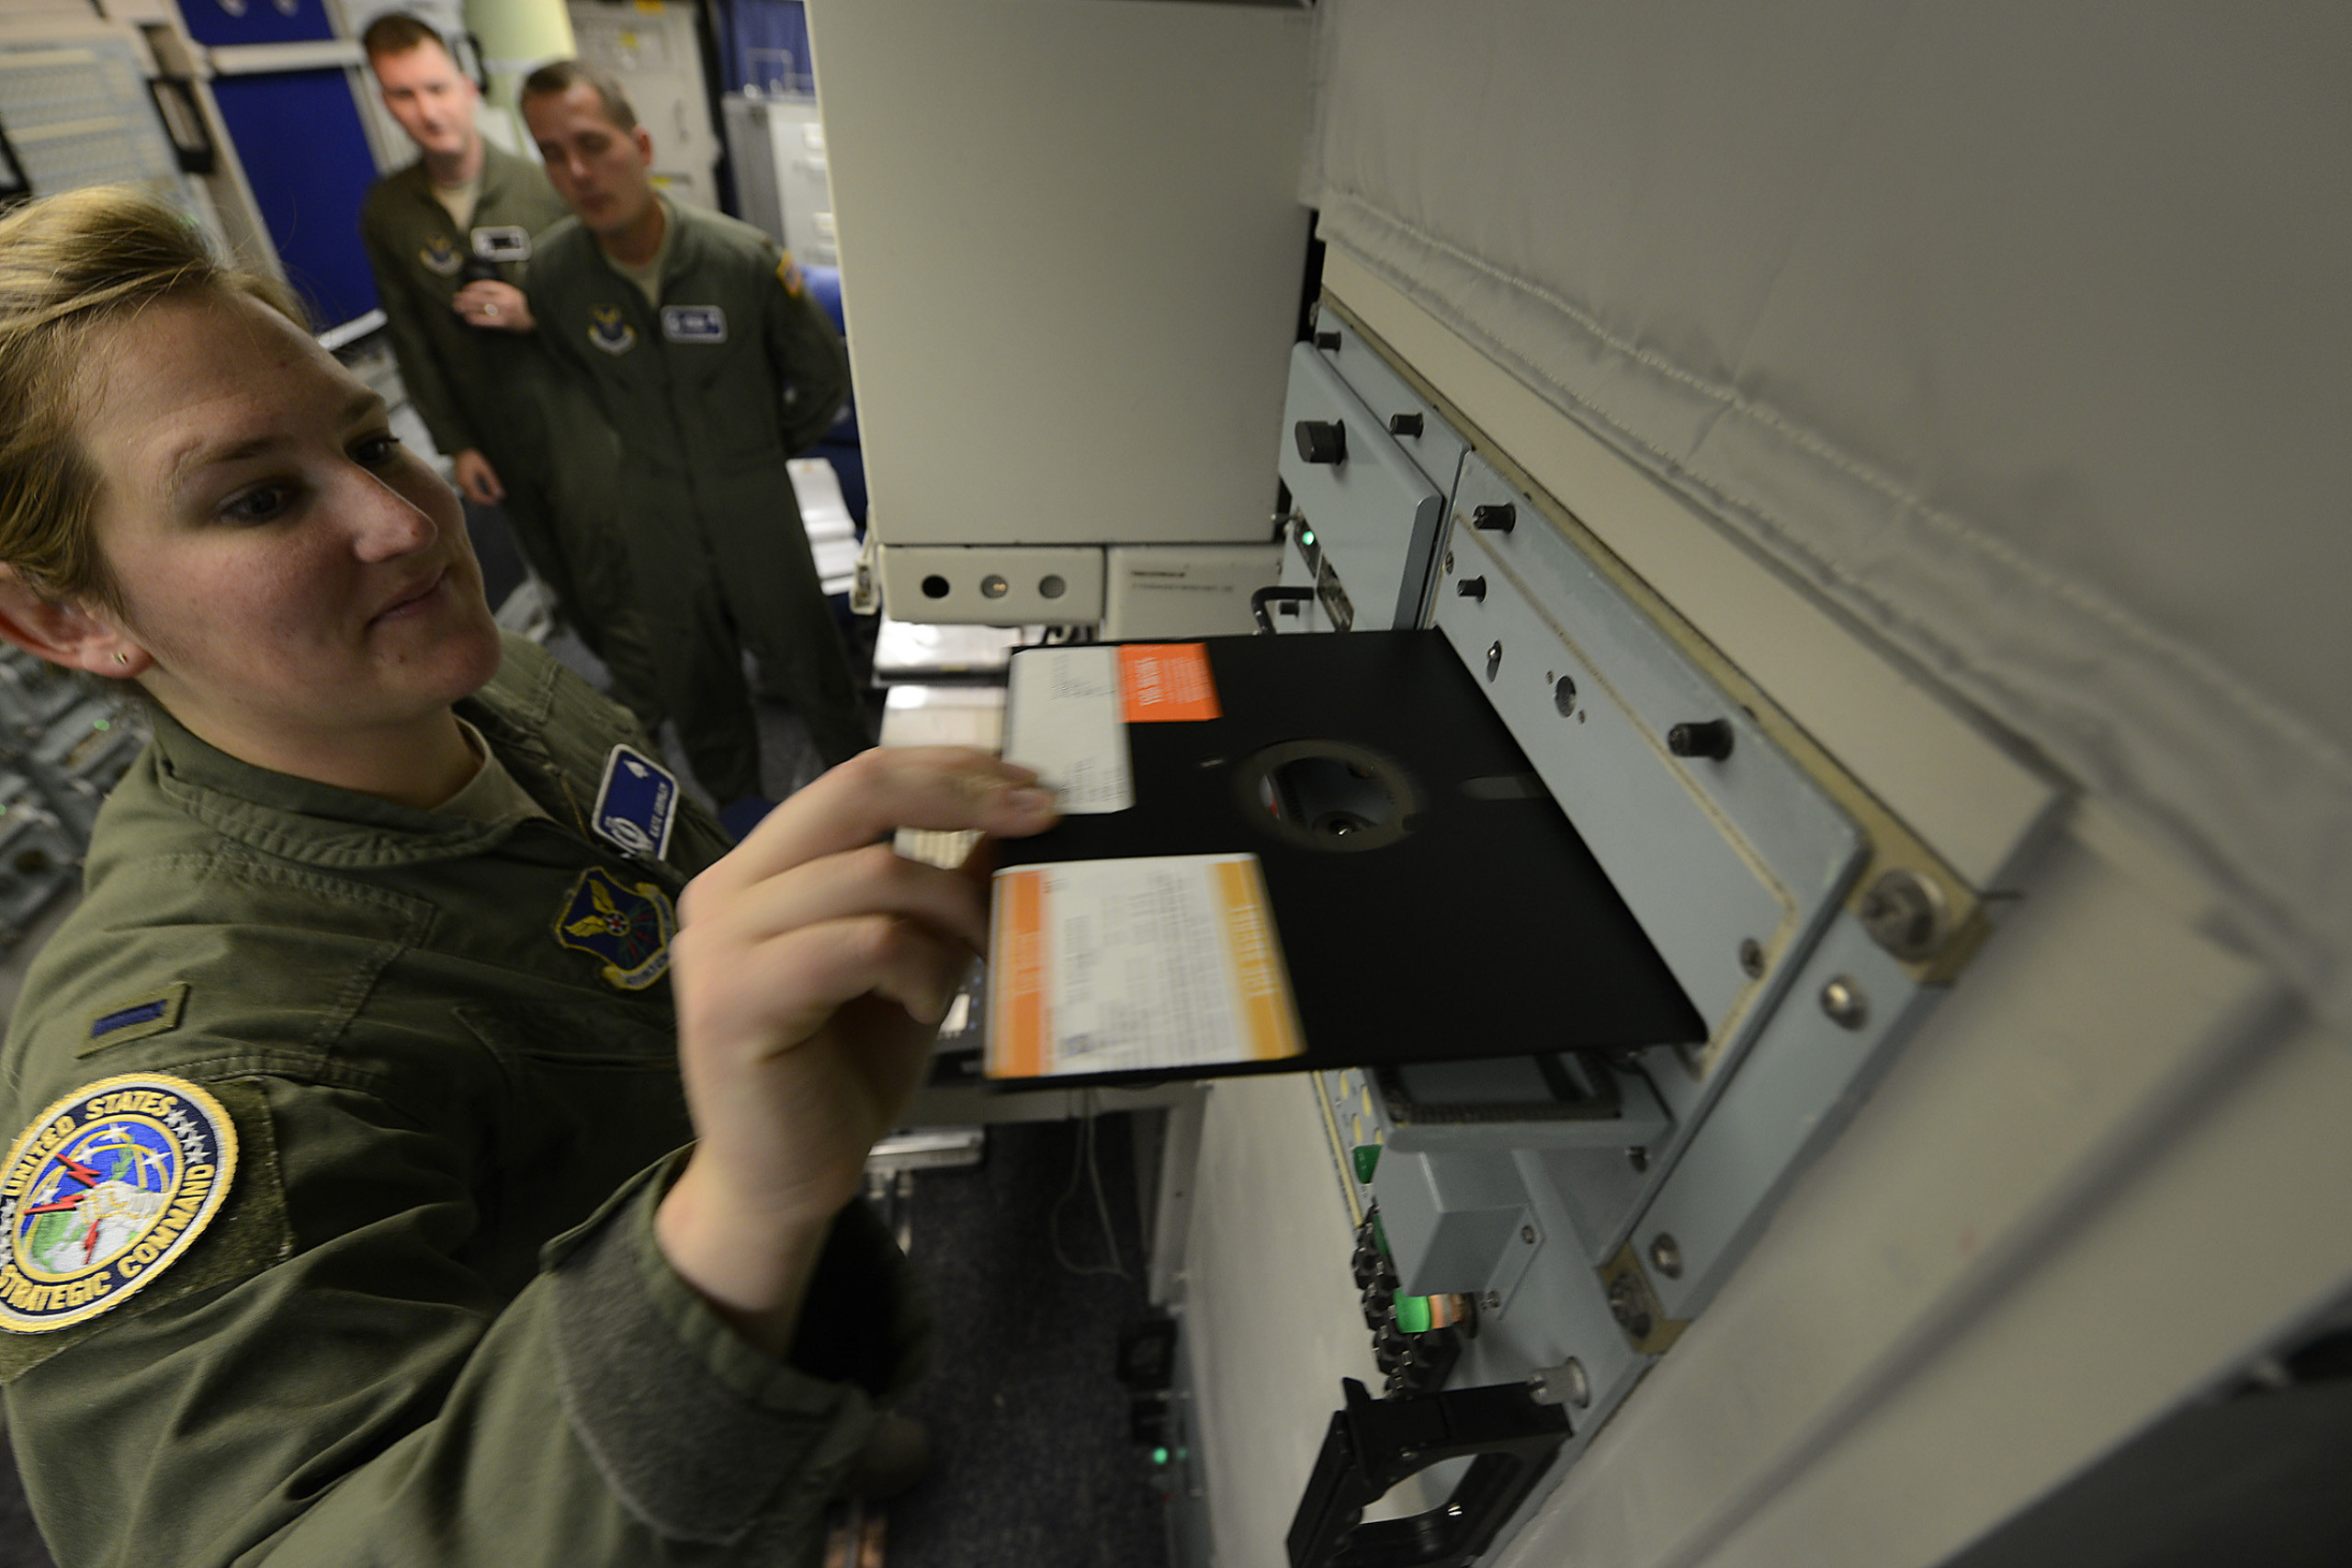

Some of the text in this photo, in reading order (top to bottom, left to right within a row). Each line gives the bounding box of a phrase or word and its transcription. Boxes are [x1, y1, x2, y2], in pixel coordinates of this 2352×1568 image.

[5, 1090, 178, 1197] UNITED STATES
[0, 1163, 216, 1311] STRATEGIC COMMAND
